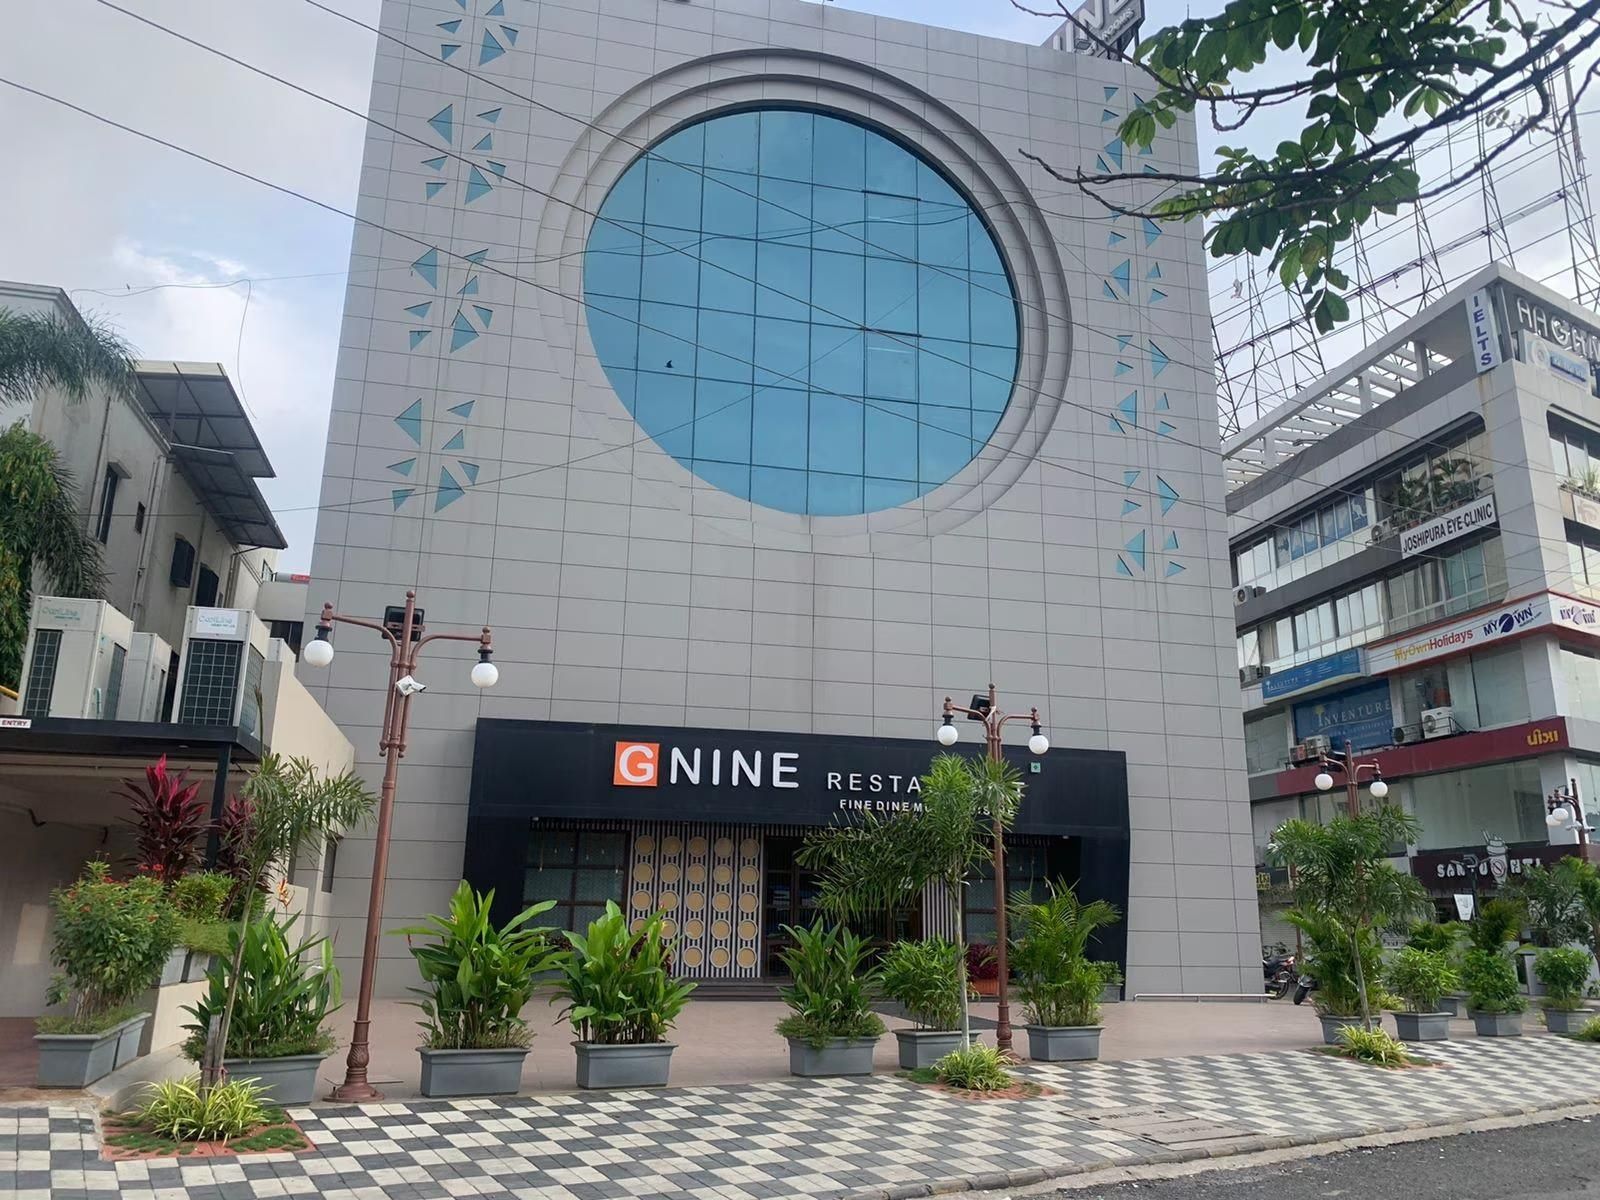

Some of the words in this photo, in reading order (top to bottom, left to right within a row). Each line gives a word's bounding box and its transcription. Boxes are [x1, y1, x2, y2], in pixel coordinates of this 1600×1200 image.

[1473, 295, 1493, 366] IELTS
[1403, 522, 1447, 553] JOSHIPURA
[1447, 516, 1463, 535] EYE
[1463, 503, 1493, 528] CLINIC
[2, 719, 28, 727] ENTRY
[839, 799, 872, 811] FINE
[876, 800, 910, 813] DINE
